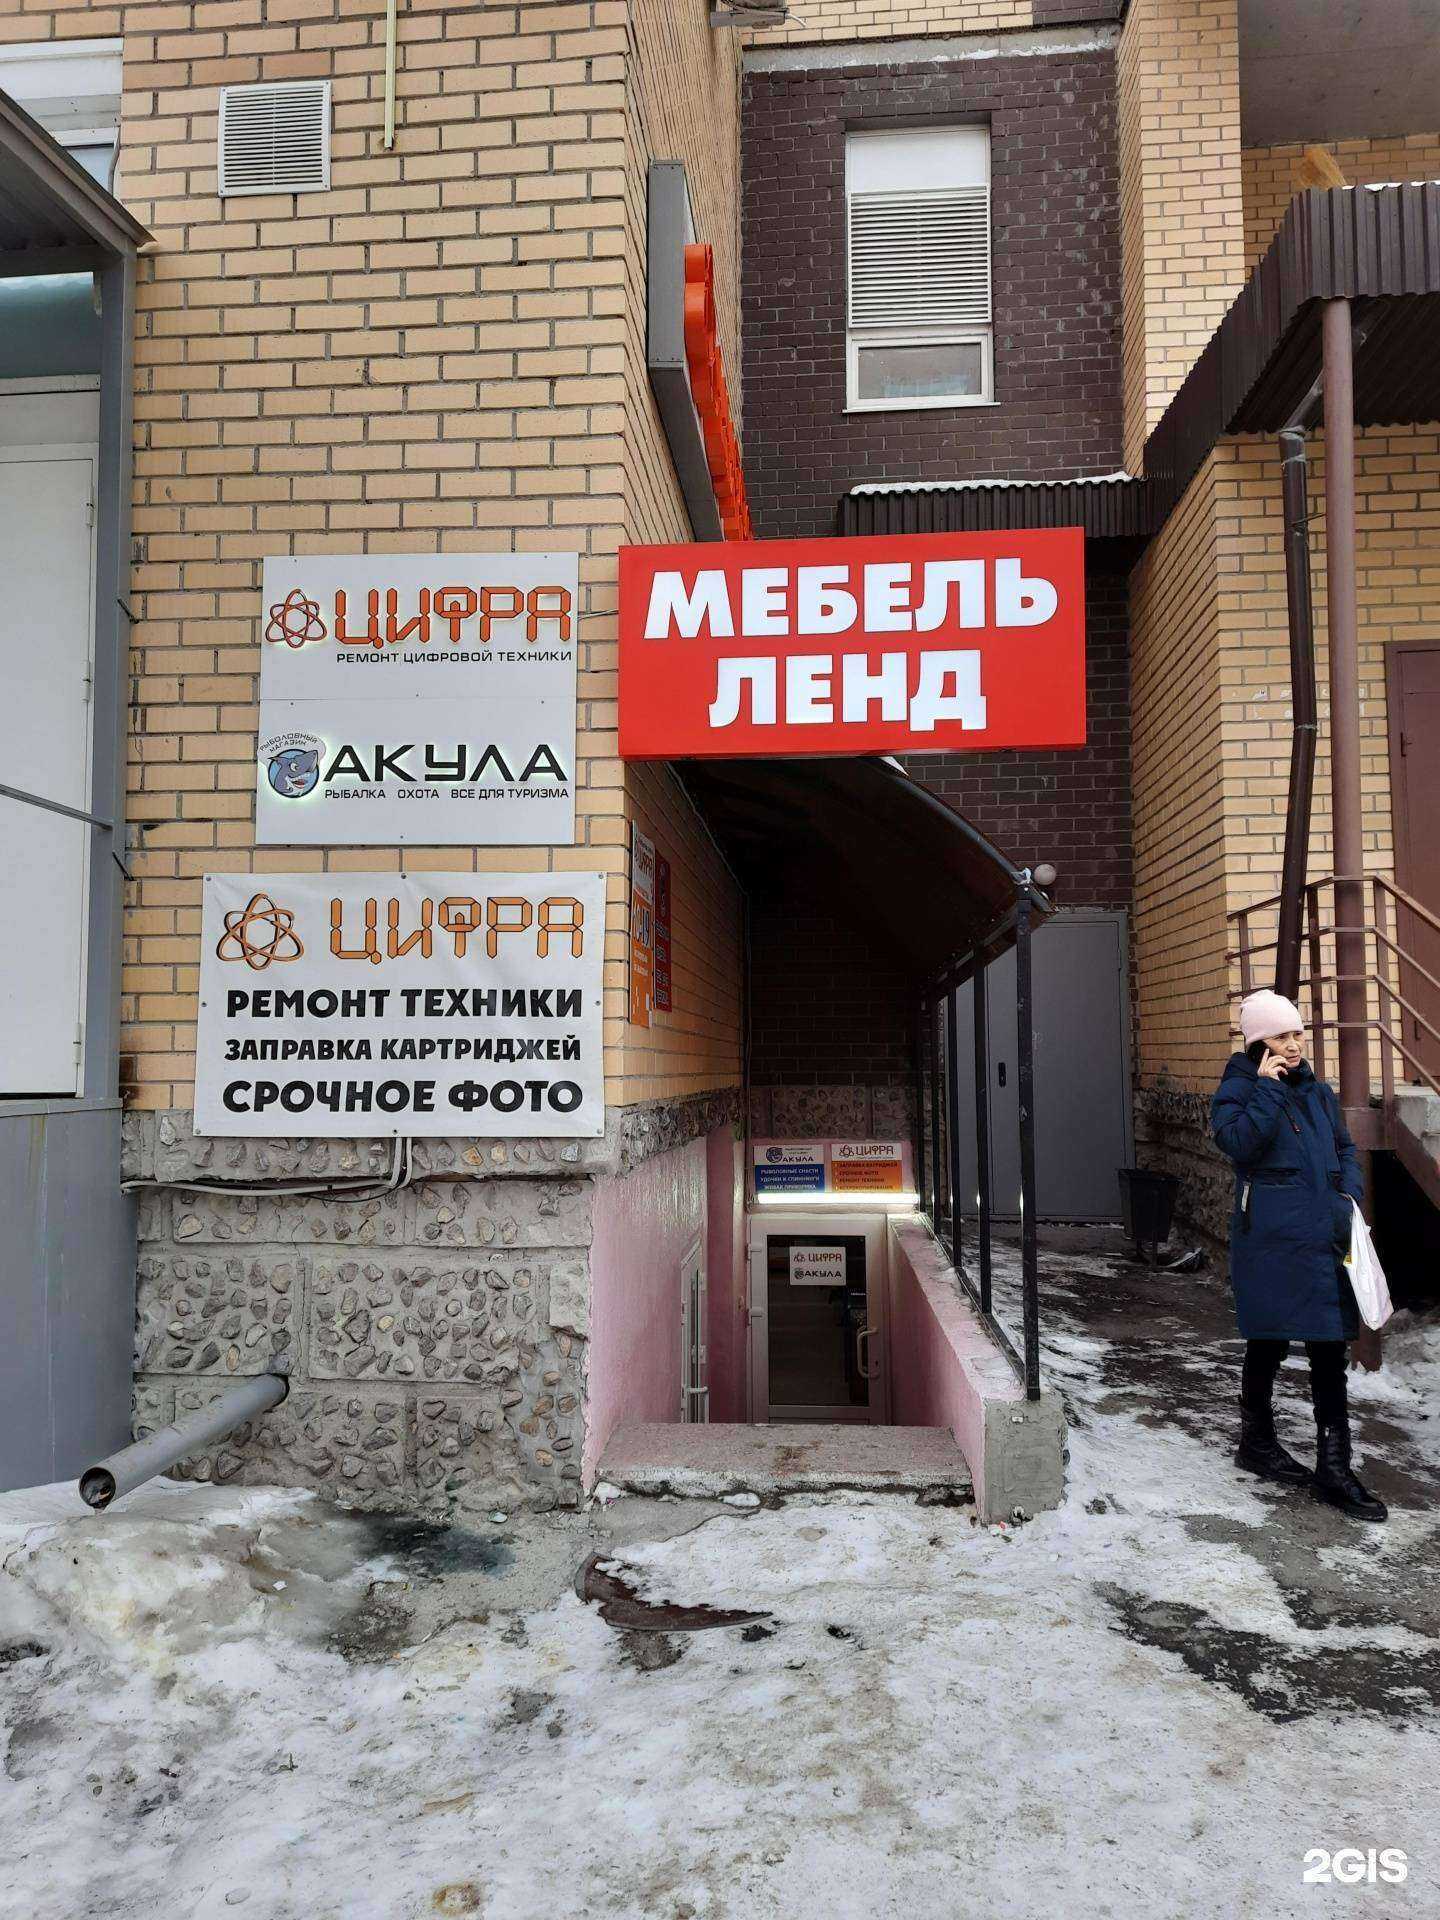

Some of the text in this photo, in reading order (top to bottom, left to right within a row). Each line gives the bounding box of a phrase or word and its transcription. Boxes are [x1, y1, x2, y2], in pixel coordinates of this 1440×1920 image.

[643, 557, 1058, 640] МЕБЕЛЬ
[335, 585, 571, 649] ЦИФРА
[336, 649, 572, 665] РЕМОНТ ЦИФРОВОЙ ТЕХНИКИ
[708, 649, 987, 732] ЛЕНД
[260, 732, 319, 752] РЫБОЛОВНЫЙ
[269, 739, 307, 753] МАГАЗИН
[323, 744, 568, 782] АКУЛА
[325, 788, 569, 801] РЫБАЛКА ОХОТА ВСЕ ДЛЯ ТУРИЗМА
[330, 896, 584, 964] ЦИФРА
[226, 989, 583, 1018] РЕМОНТ ТЕХНИКИ
[224, 1034, 581, 1063] ЗАПРАВКА КАРТРИДЖЕЙ
[222, 1080, 583, 1113] СРОЧНОЕ ФОТО
[782, 1155, 814, 1163] АКУЛА
[855, 1145, 894, 1156] ЦИФРА
[808, 1253, 842, 1262] ЦИФРА
[804, 1270, 842, 1278] АКУЛА
